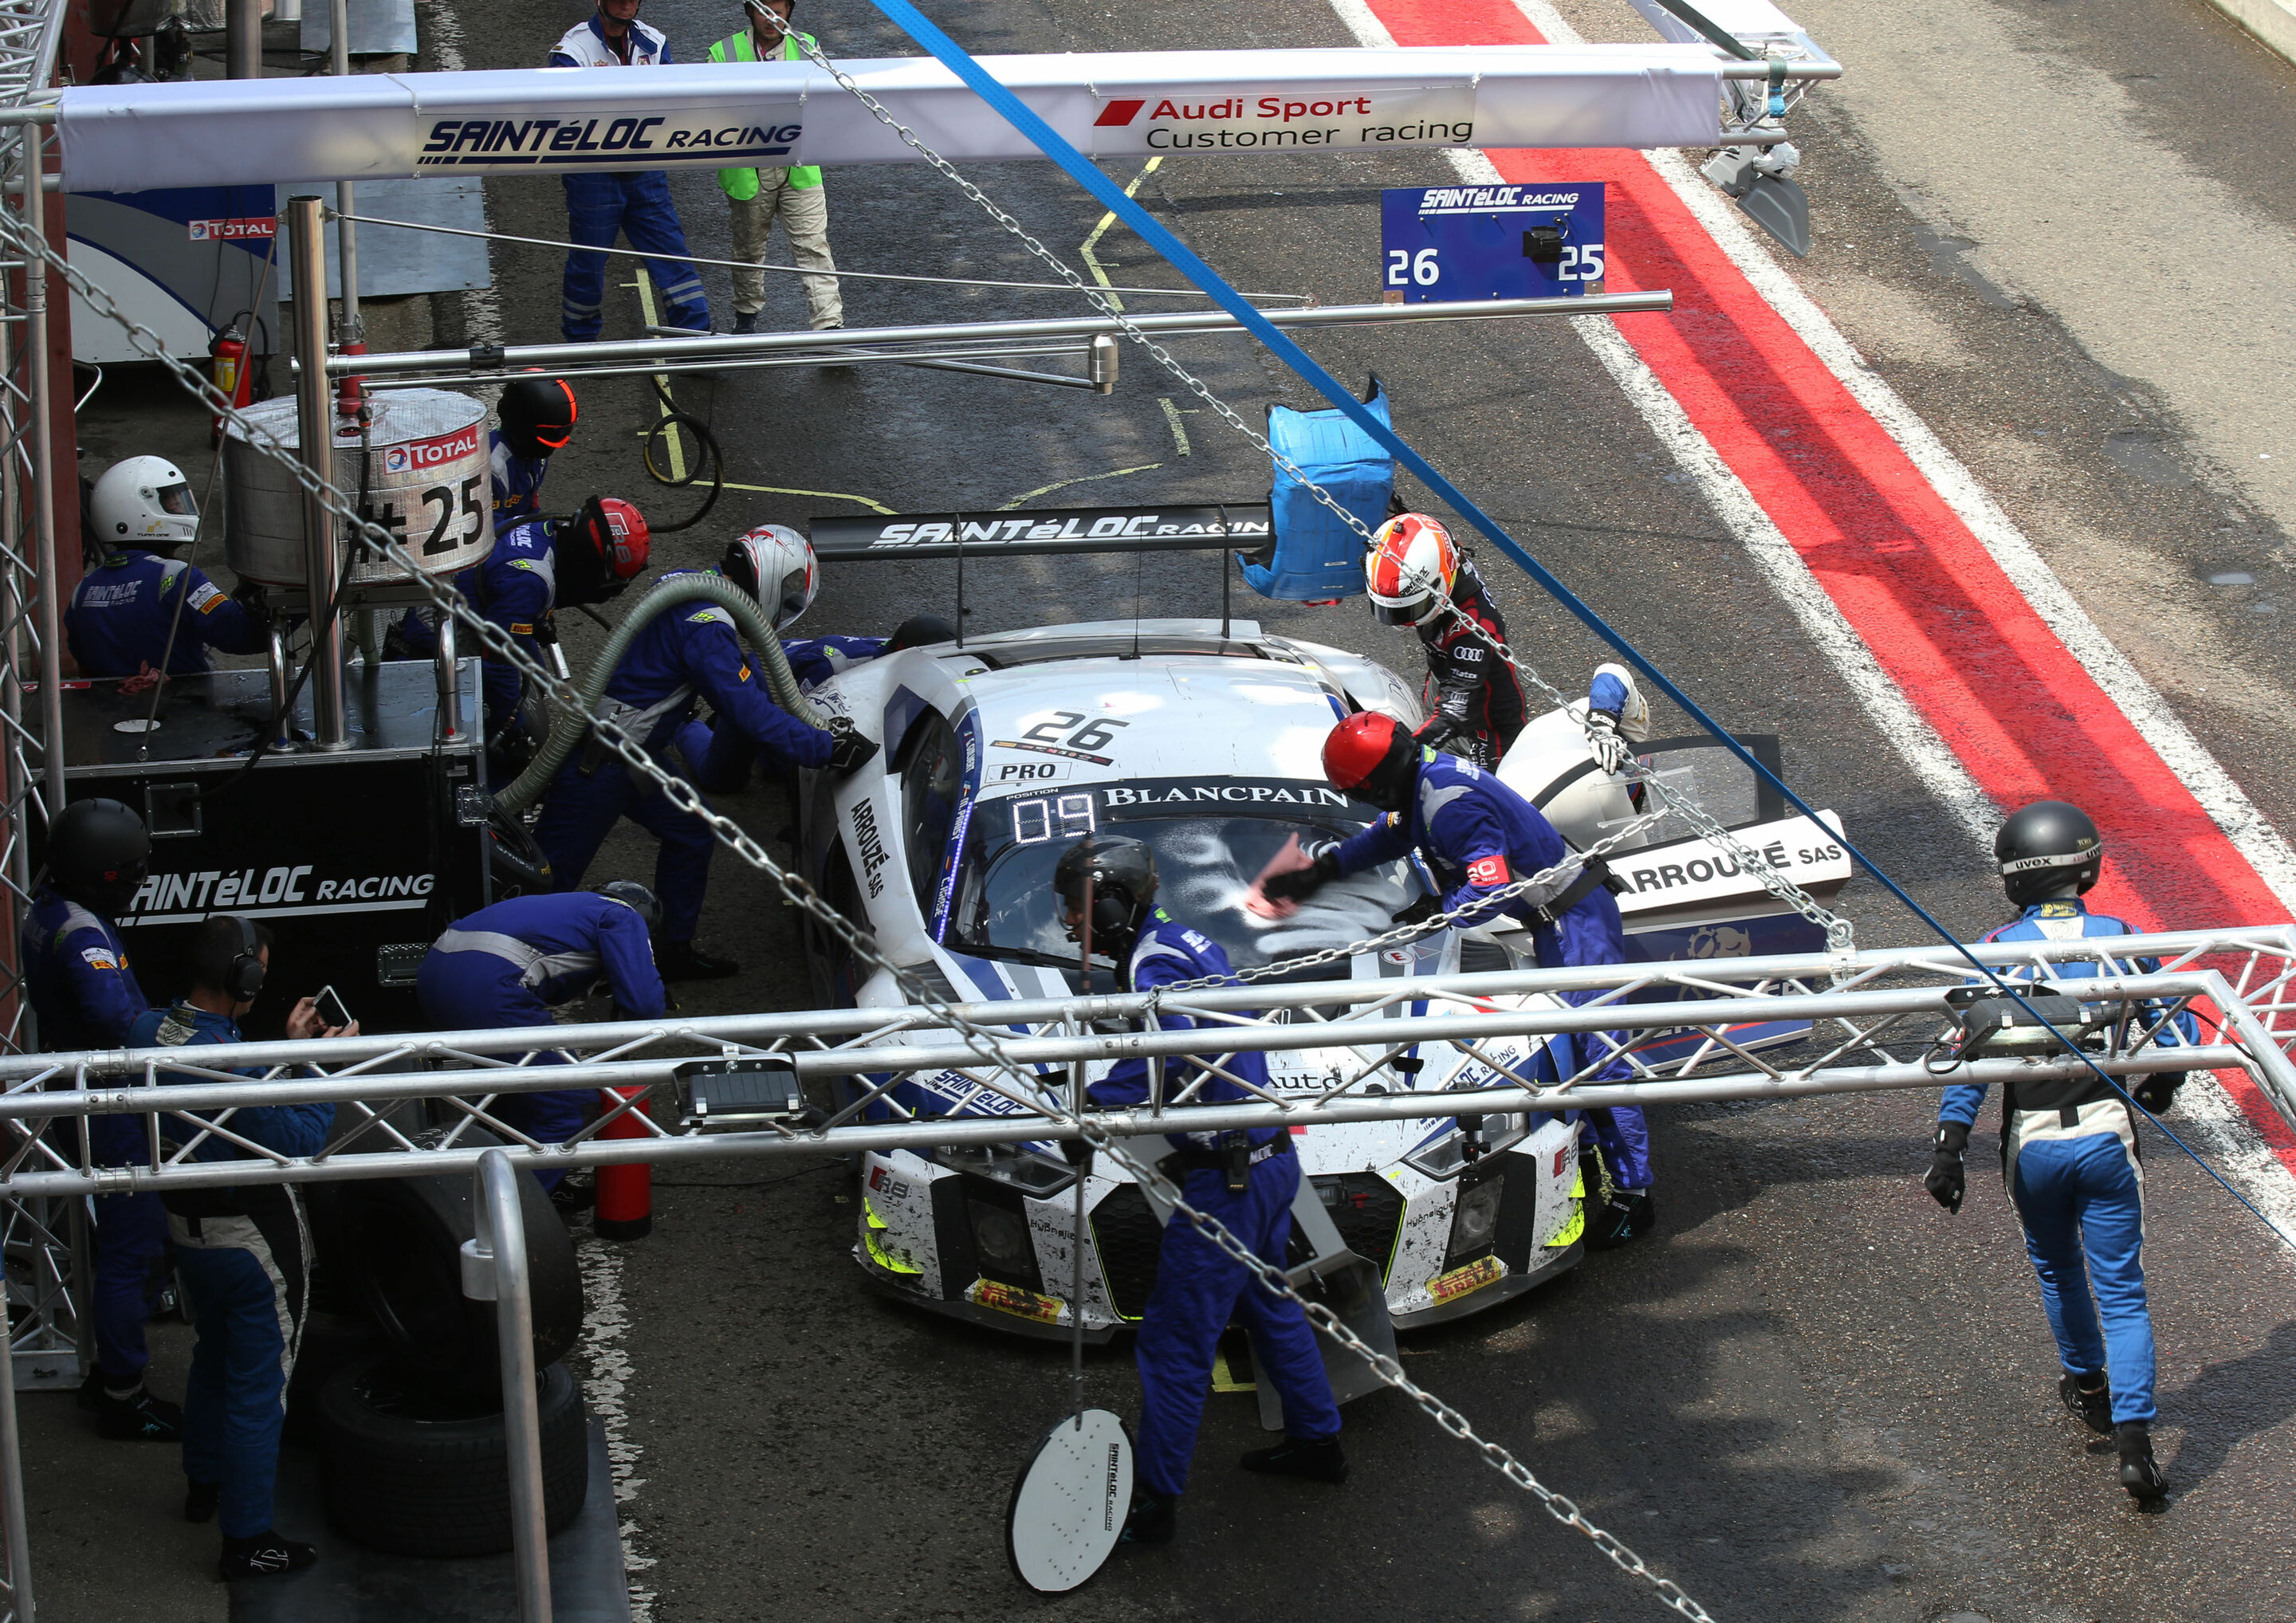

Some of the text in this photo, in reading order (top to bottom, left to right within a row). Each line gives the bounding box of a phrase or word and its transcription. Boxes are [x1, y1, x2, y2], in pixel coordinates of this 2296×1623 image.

[1150, 96, 1371, 122] Audi Sport
[423, 116, 802, 152] SAINTéLOC RACING
[1146, 120, 1472, 149] Customer racing
[1420, 187, 1579, 208] SAINTéLOC RACING
[209, 222, 273, 236] TOTAL
[1388, 248, 1440, 286] 26
[1559, 244, 1605, 281] 25
[411, 436, 477, 464] TOTAL
[422, 474, 485, 556] 25
[875, 515, 1270, 544] SAINTéLOC RACIN
[1020, 711, 1130, 751] 26
[1000, 764, 1056, 780] PRO
[1005, 788, 1059, 801] POSITION
[1102, 787, 1350, 808] BLANCPAIN
[851, 797, 890, 900] ARROUZÉ SAS
[1798, 844, 1842, 865] SAS
[2015, 857, 2052, 870] uvex
[130, 865, 435, 911] AINTéLOC RACING
[934, 1069, 1024, 1116] SAINéLOC
[1271, 1073, 1342, 1090] uto
[876, 1174, 910, 1198] R8
